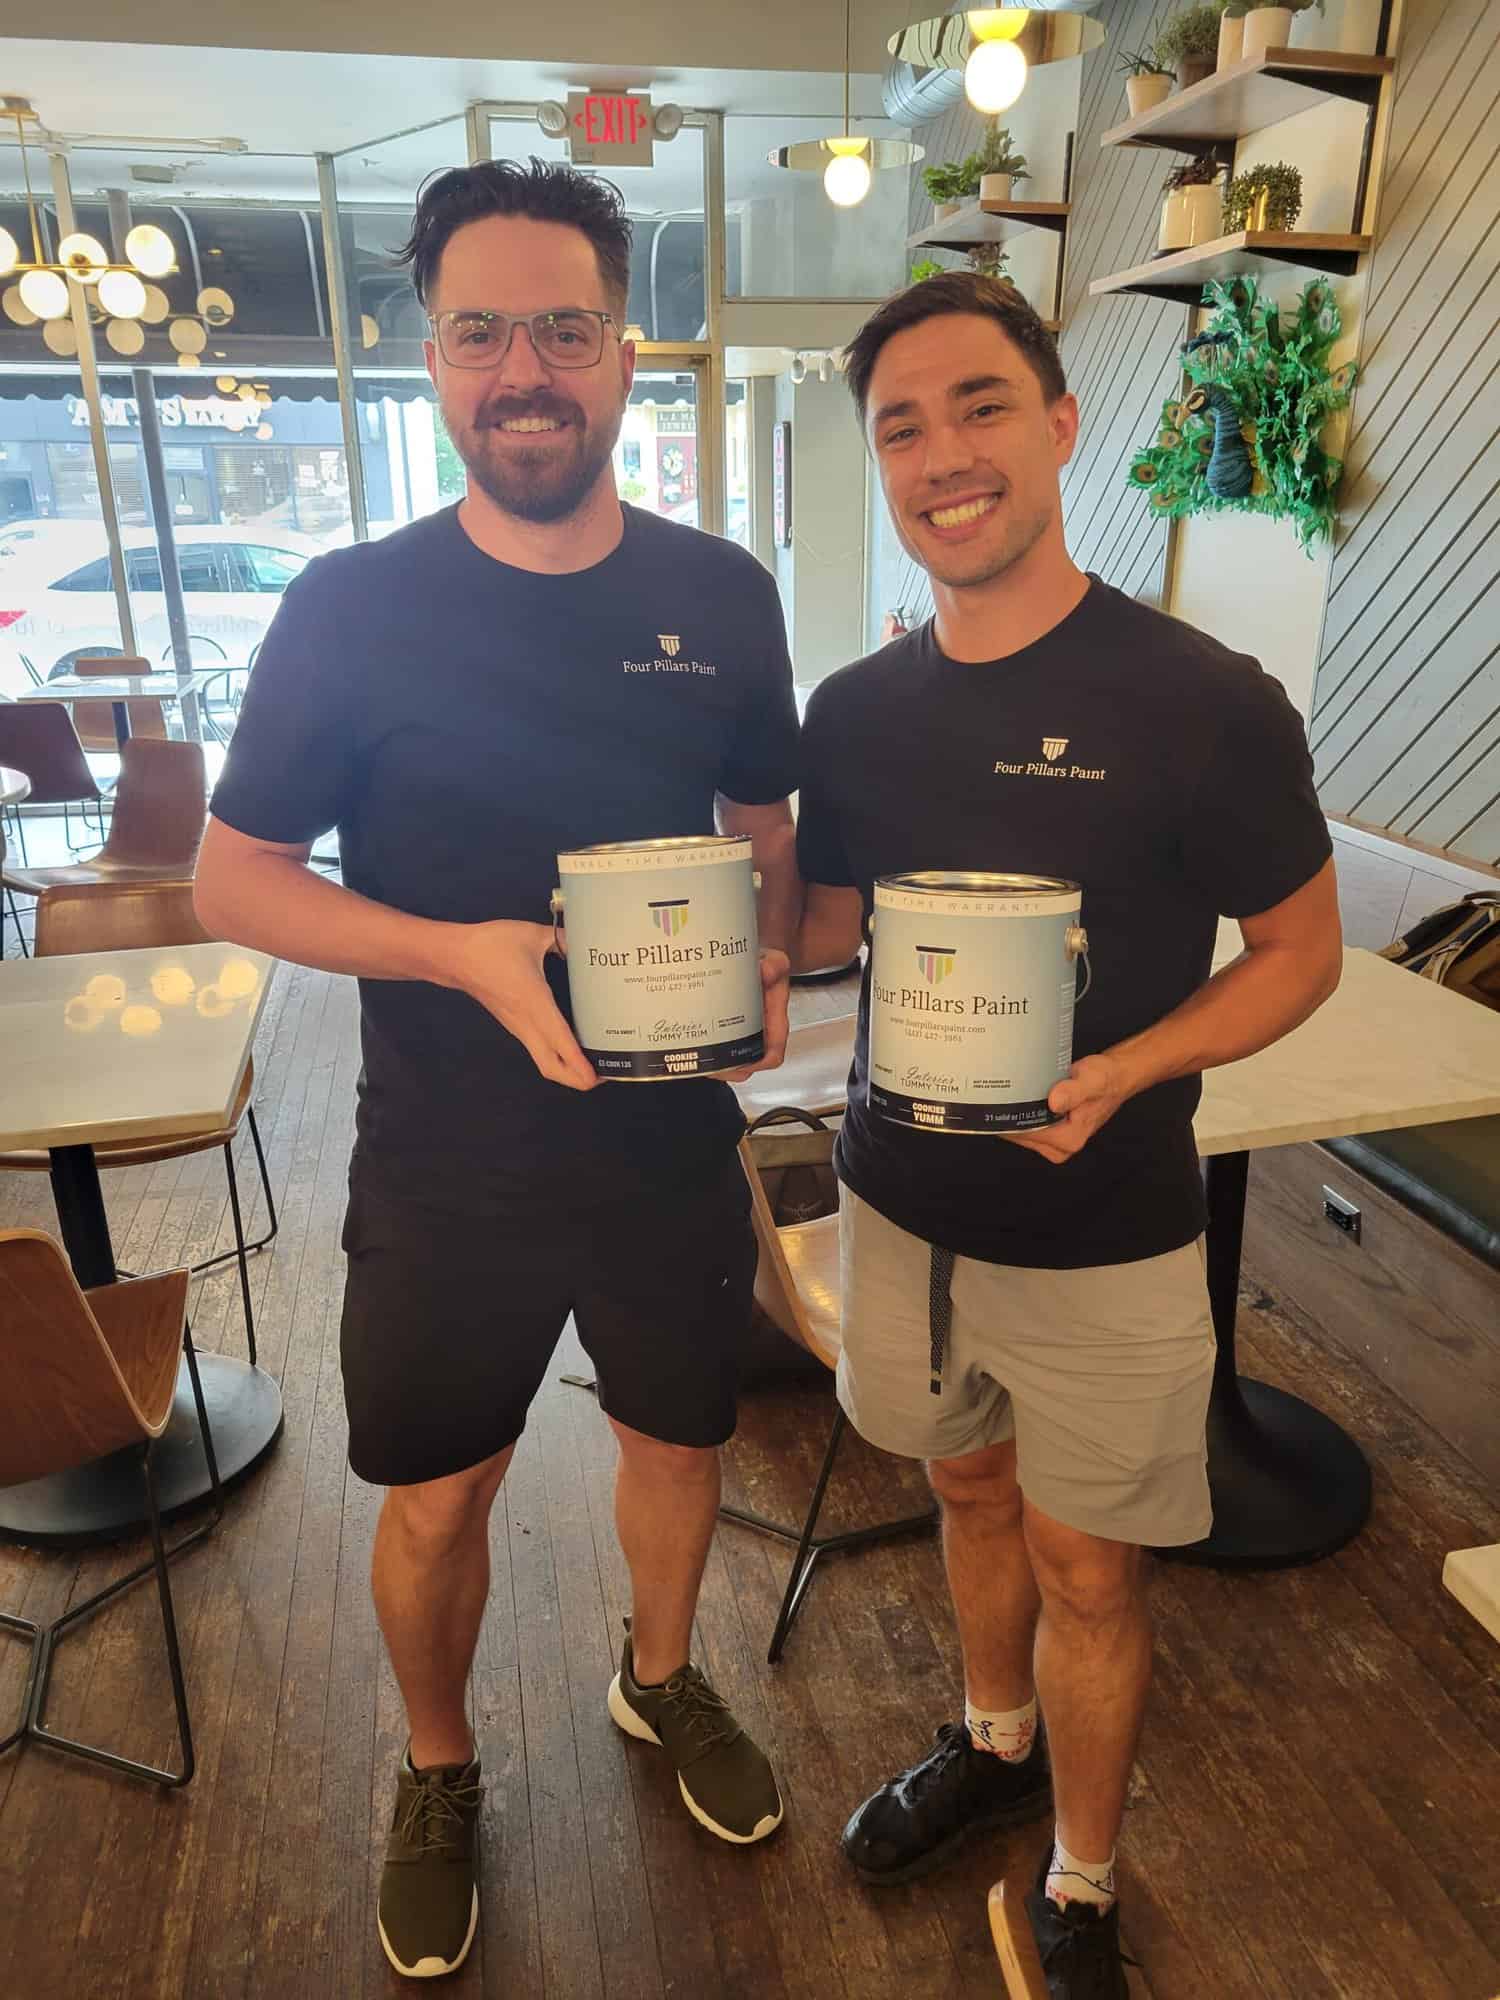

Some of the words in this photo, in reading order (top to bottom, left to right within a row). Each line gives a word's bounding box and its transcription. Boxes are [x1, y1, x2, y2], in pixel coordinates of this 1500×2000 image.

[585, 96, 640, 144] EXIT
[623, 661, 651, 673] Four
[654, 659, 689, 673] Pillars
[691, 661, 716, 676] Paint
[994, 761, 1023, 774] Four
[1025, 762, 1067, 777] Pillars
[1069, 766, 1106, 780] Paint
[949, 901, 1041, 912] WARRANTY
[588, 948, 630, 967] Four
[636, 944, 703, 966] Pillars
[708, 936, 748, 959] Paint
[901, 988, 965, 1014] Pillars
[972, 995, 1030, 1015] Paint
[648, 1030, 682, 1042] TUMMY
[685, 1029, 708, 1040] TRIM
[664, 1052, 699, 1063] COOKIES
[666, 1061, 699, 1073] YUMM
[900, 1078, 931, 1091] TUMMY
[935, 1084, 959, 1095] TRIM
[912, 1102, 946, 1114] COOKIES
[913, 1112, 945, 1125] YUMM
